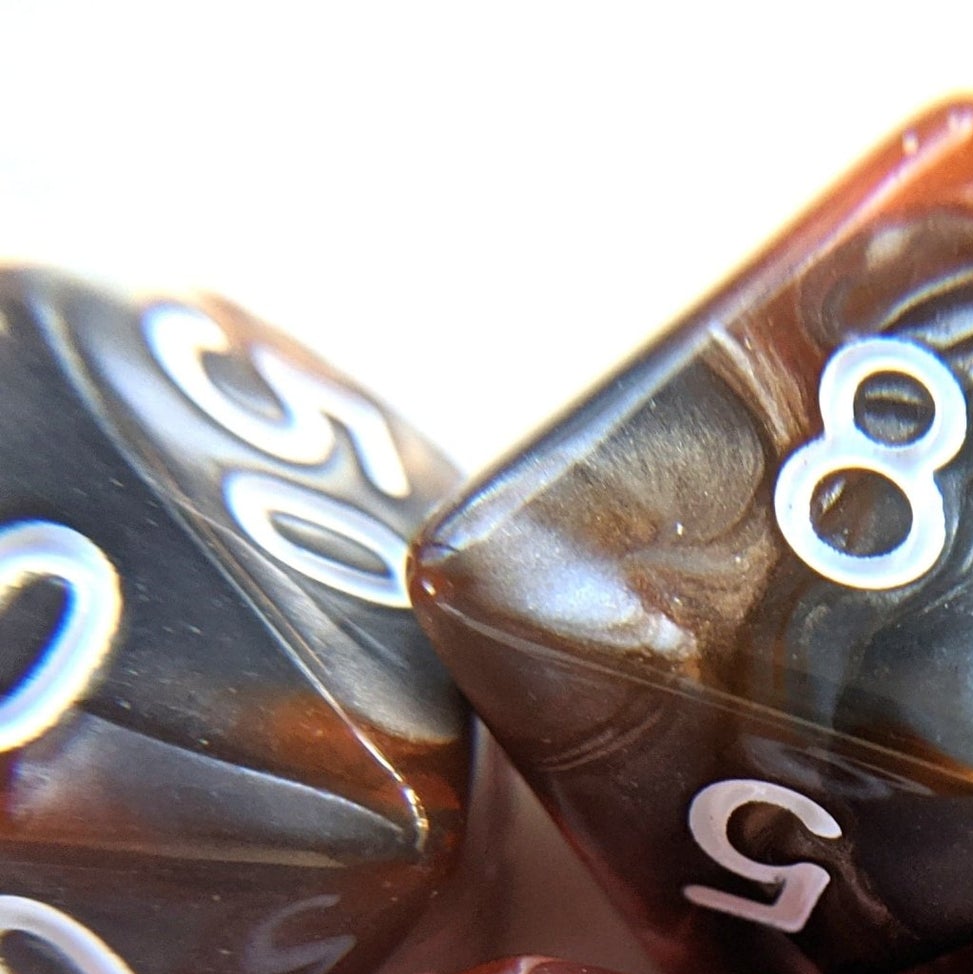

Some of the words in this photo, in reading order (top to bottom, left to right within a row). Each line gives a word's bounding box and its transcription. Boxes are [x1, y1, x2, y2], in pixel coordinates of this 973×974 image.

[140, 302, 411, 608] 50
[773, 335, 968, 590] 8
[682, 779, 843, 933] 5
